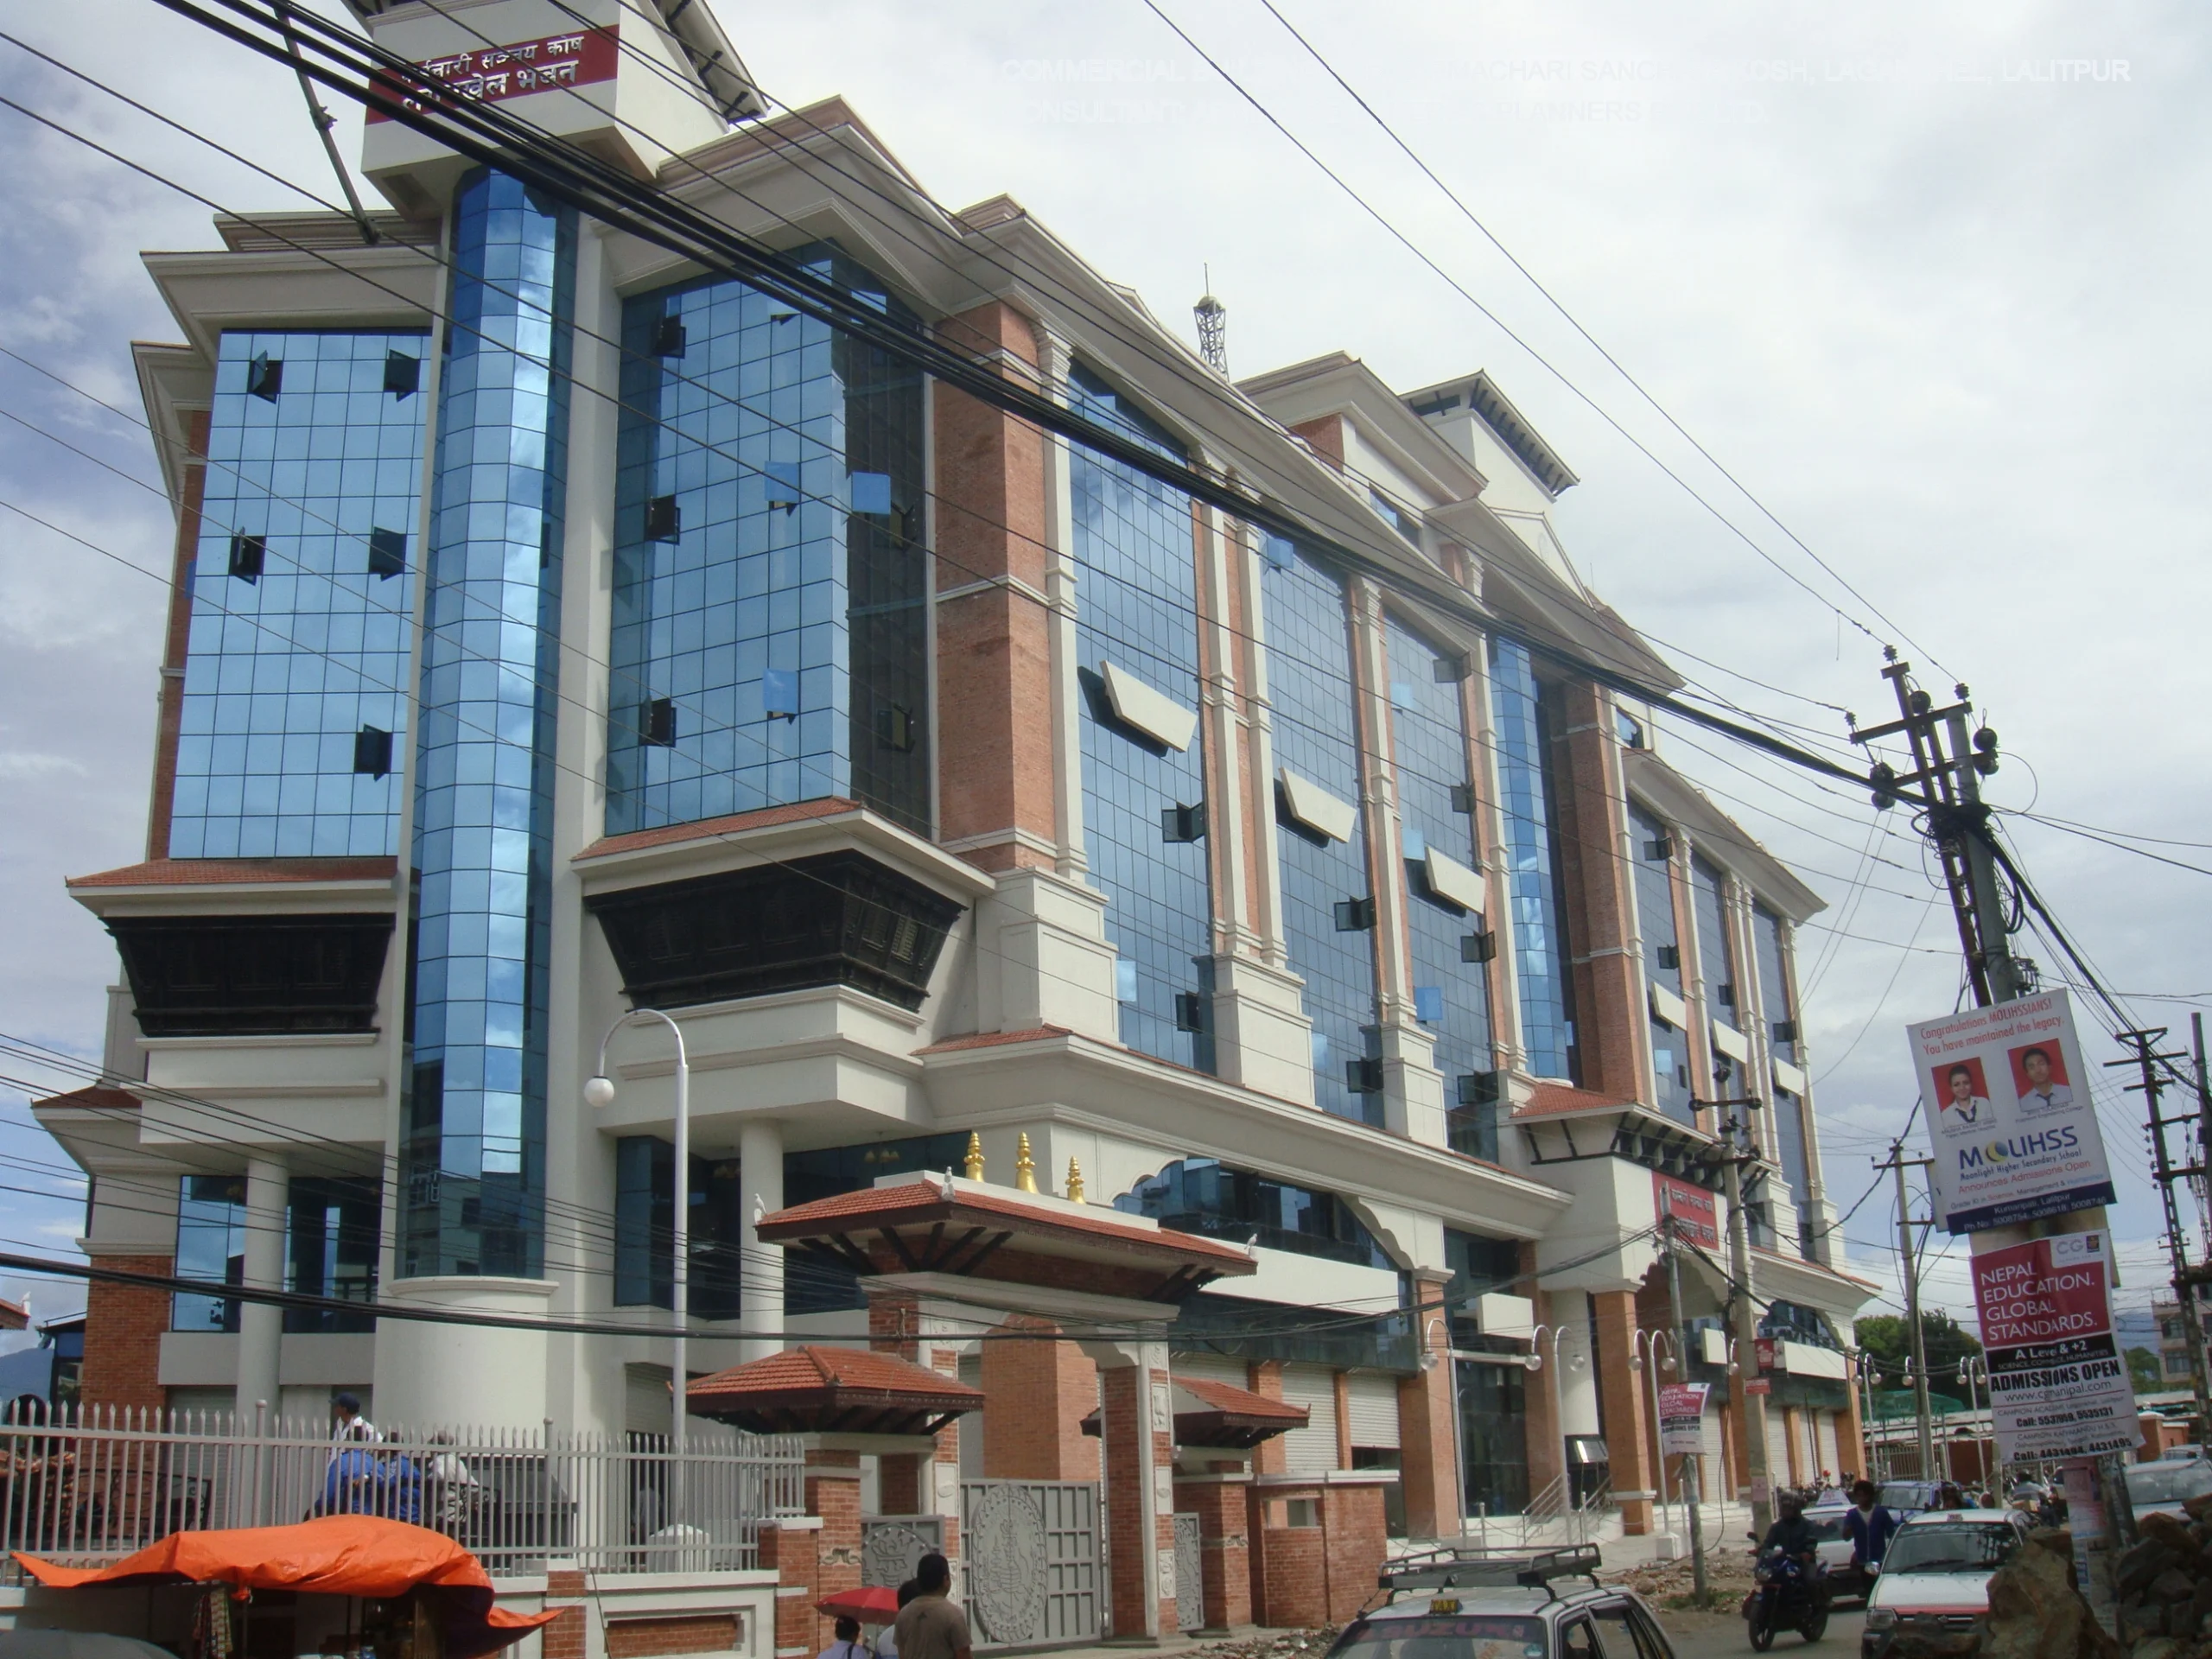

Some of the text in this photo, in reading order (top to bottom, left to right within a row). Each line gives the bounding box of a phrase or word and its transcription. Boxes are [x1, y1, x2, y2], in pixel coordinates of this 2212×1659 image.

[547, 35, 585, 56] कोष
[1920, 1016, 1987, 1040] Congratulations
[1923, 1044, 1942, 1056] You
[1943, 1039, 1964, 1052] have
[1966, 1023, 2016, 1046] maintained
[2017, 1021, 2031, 1033] the
[1960, 1147, 2082, 1181] Moonlight Higher Secondary School
[1958, 1160, 2091, 1194] Announces Admissions Open
[2056, 1239, 2084, 1255] CG
[1980, 1262, 2037, 1287] NEPAL
[1983, 1272, 2095, 1304] EDUCATION.
[1986, 1299, 2056, 1321] GLOBAL
[1987, 1312, 2098, 1341] STANDARDS.
[2014, 1349, 2027, 1361] A
[2059, 1342, 2069, 1354] &
[2071, 1339, 2088, 1351] +2
[1990, 1359, 2121, 1393] ADMISSIONS OPEN
[2016, 1417, 2037, 1428] Call:
[2076, 1406, 2114, 1421] 5535131
[2013, 1449, 2038, 1462] Call:
[2088, 1437, 2133, 1452] 4431495
[1381, 1621, 1510, 1638] SUZUK
